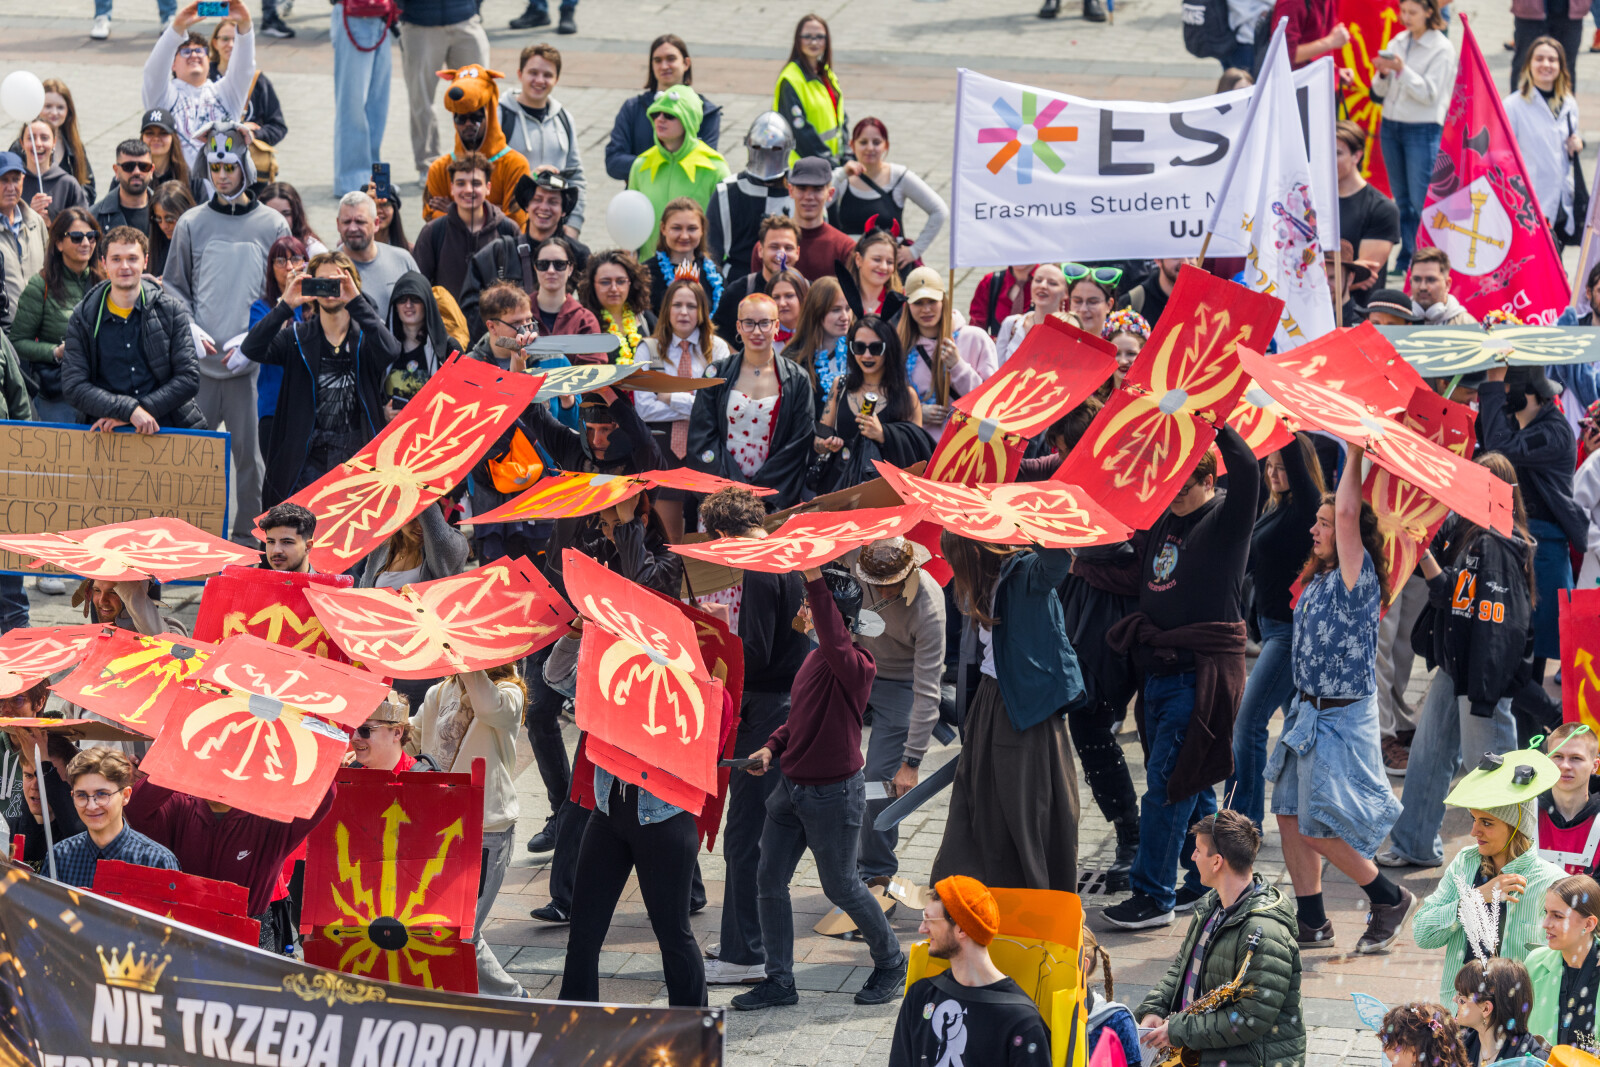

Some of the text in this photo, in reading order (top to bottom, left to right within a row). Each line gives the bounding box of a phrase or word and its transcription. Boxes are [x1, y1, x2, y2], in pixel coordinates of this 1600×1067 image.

[1098, 85, 1311, 176] ES
[974, 200, 1077, 221] Erasmus
[1091, 191, 1191, 214] Student
[1170, 219, 1204, 238] UJ
[8, 427, 219, 472] SESJA MNIE SZUKA,
[25, 463, 82, 500] MNIE
[1478, 600, 1505, 624] 90
[91, 983, 166, 1048] NIE
[176, 997, 344, 1067] TRZEBA
[350, 1017, 542, 1067] KORONY
